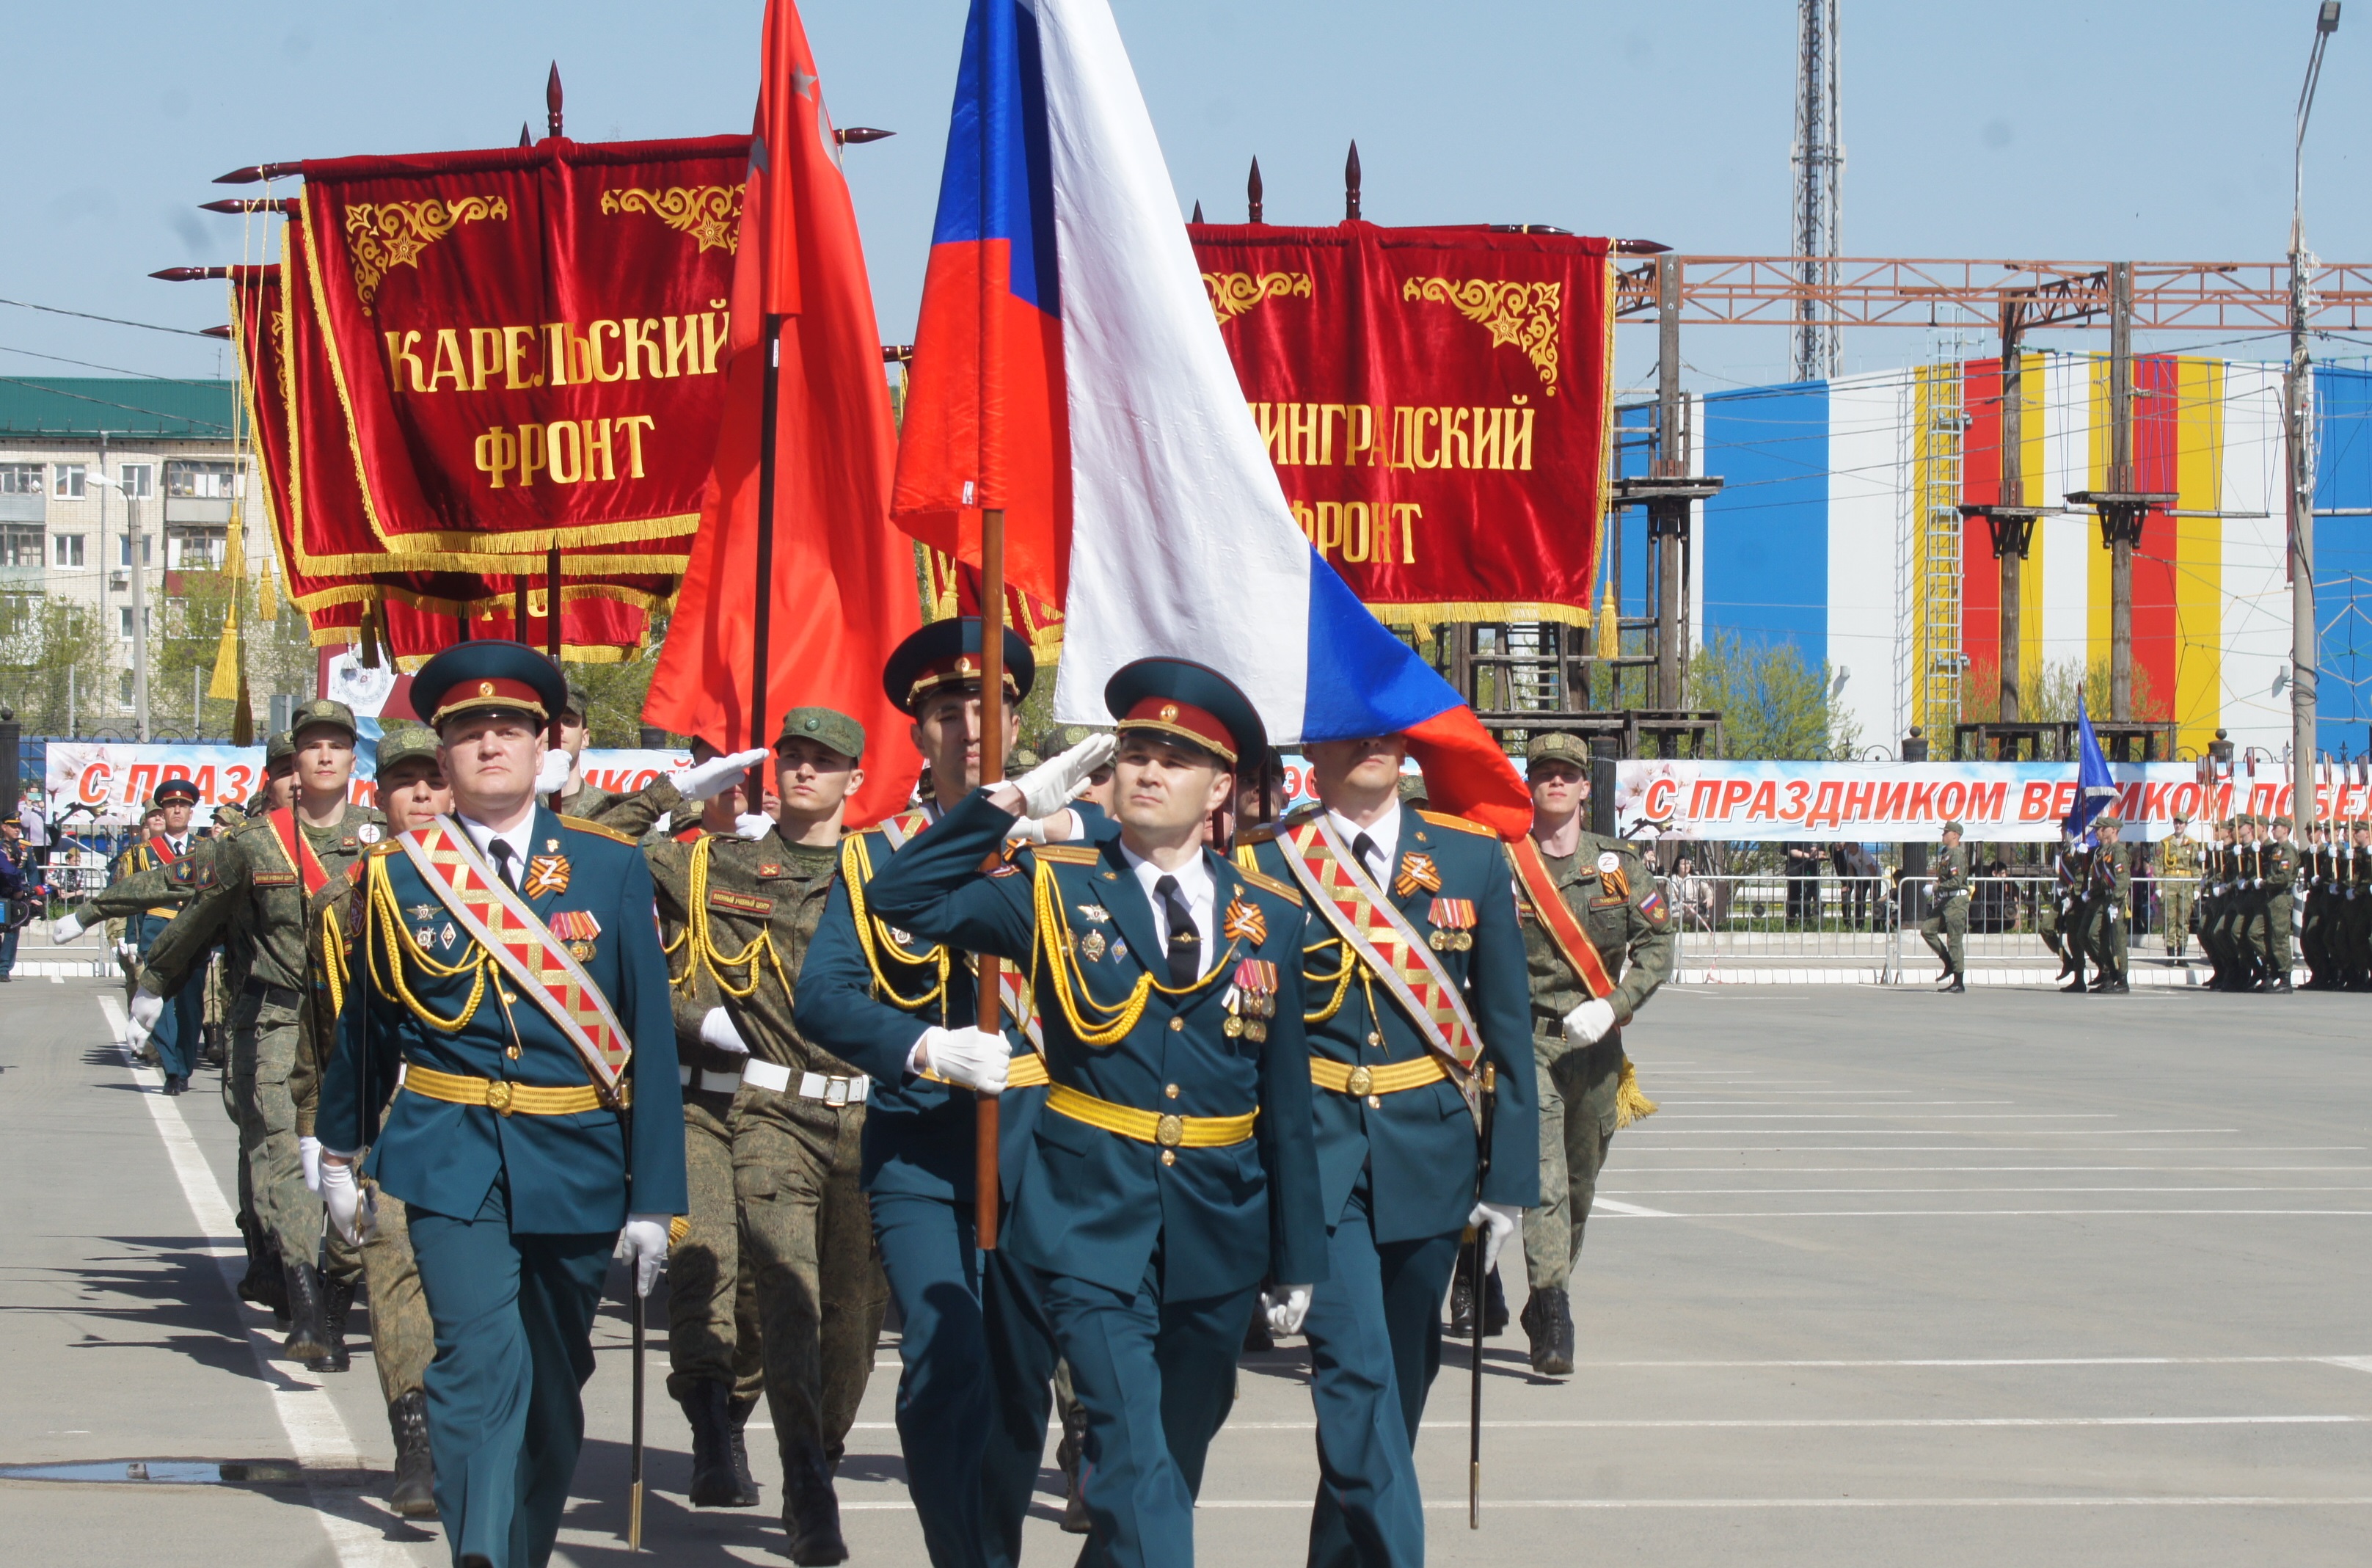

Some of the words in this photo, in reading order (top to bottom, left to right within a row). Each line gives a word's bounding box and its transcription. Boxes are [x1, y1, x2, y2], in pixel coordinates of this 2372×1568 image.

[384, 298, 730, 392] КАРЕЛЬСКИЙ
[475, 415, 655, 488] ФРОНТ
[1247, 395, 1535, 474] ИНГРАДСКИЙ
[79, 763, 109, 803] С
[1646, 779, 1676, 820] С
[1688, 780, 2008, 828] ПРАЗДНИКОМ
[2018, 772, 2233, 821] ВЕИКОЙ
[2246, 782, 2372, 822] ПОБЕ
[539, 858, 563, 885] Z
[1408, 856, 1430, 880] Z
